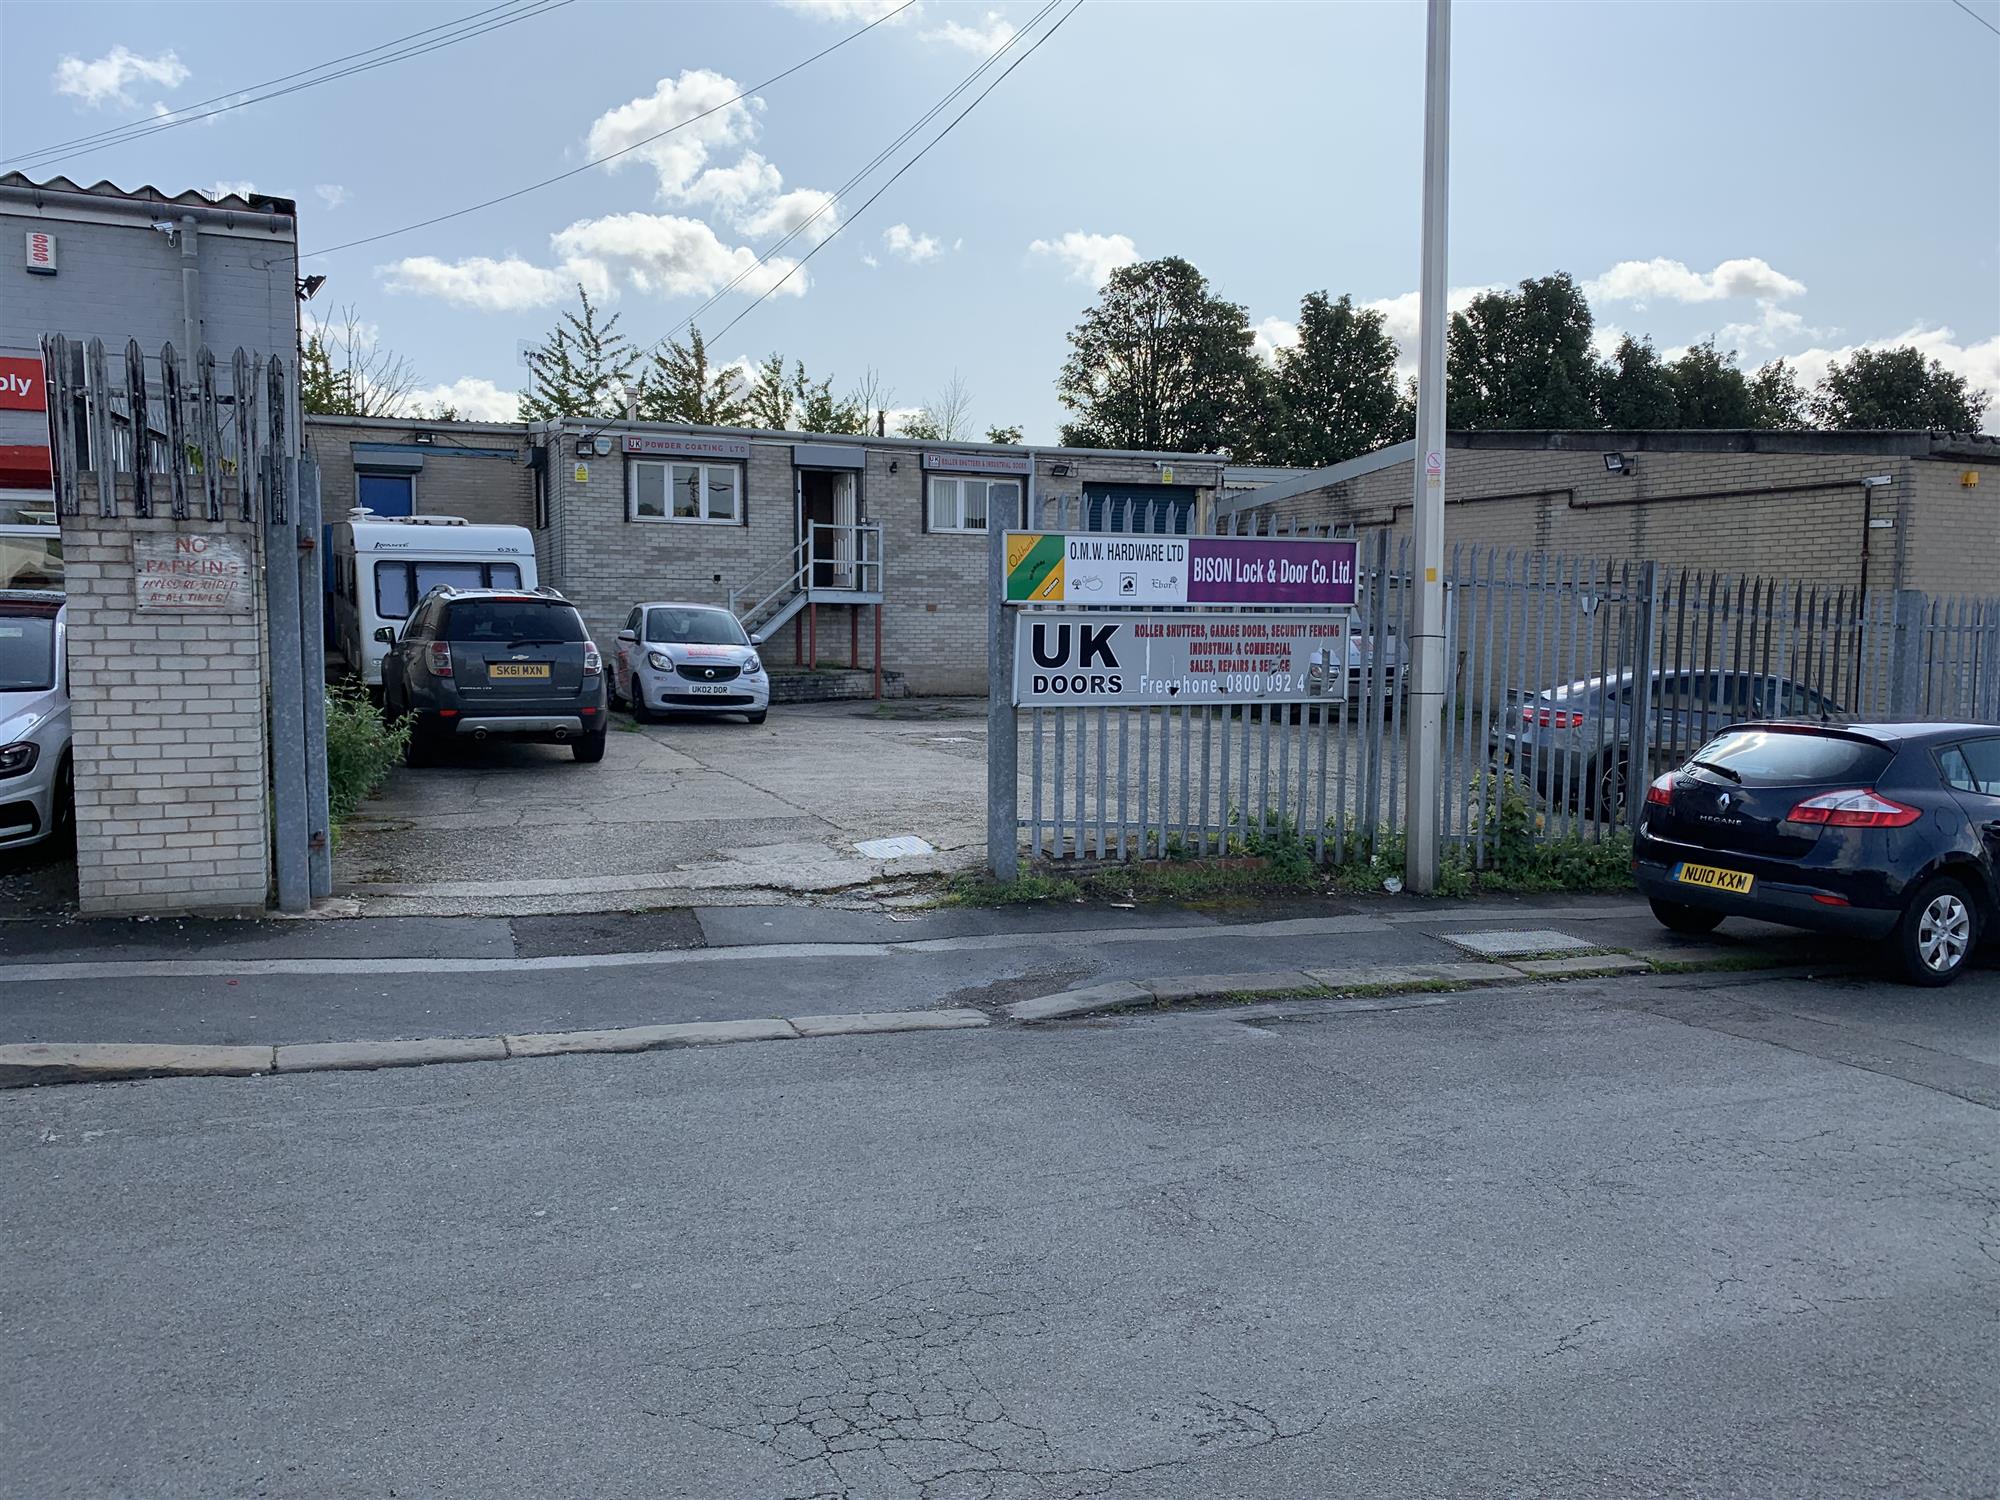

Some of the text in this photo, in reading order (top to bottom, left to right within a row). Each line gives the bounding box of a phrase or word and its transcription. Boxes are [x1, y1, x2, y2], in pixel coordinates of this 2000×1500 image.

[629, 438, 641, 448] UK
[645, 441, 681, 449] POWDER
[685, 444, 723, 452] COATING
[175, 536, 209, 553] NO
[1070, 541, 1184, 562] O.M.W. HARDWARE LTD
[146, 559, 239, 577] PARKING
[1193, 557, 1353, 584] BISON Lock & Door Co. Ltd.
[1134, 624, 1340, 640] ROLLER SHUTTERS, GARAGE DOORS, SECURITY FENCING
[1031, 623, 1122, 669] UK
[1189, 642, 1292, 656] INDUSTRIAL & COMMERCIAL
[496, 666, 543, 675] SK61 MXN
[1189, 659, 1216, 675] SALES,
[1218, 659, 1250, 673] REPAIRS
[1251, 659, 1257, 673] &
[691, 685, 728, 694] UK02 DOR
[1032, 674, 1123, 695] DOORS
[1140, 674, 1218, 698] Freephone
[1226, 674, 1260, 693] 0800
[1266, 674, 1292, 693] 092
[1700, 815, 1742, 826] MEGANE
[1684, 866, 1747, 890] NU10 KXM
